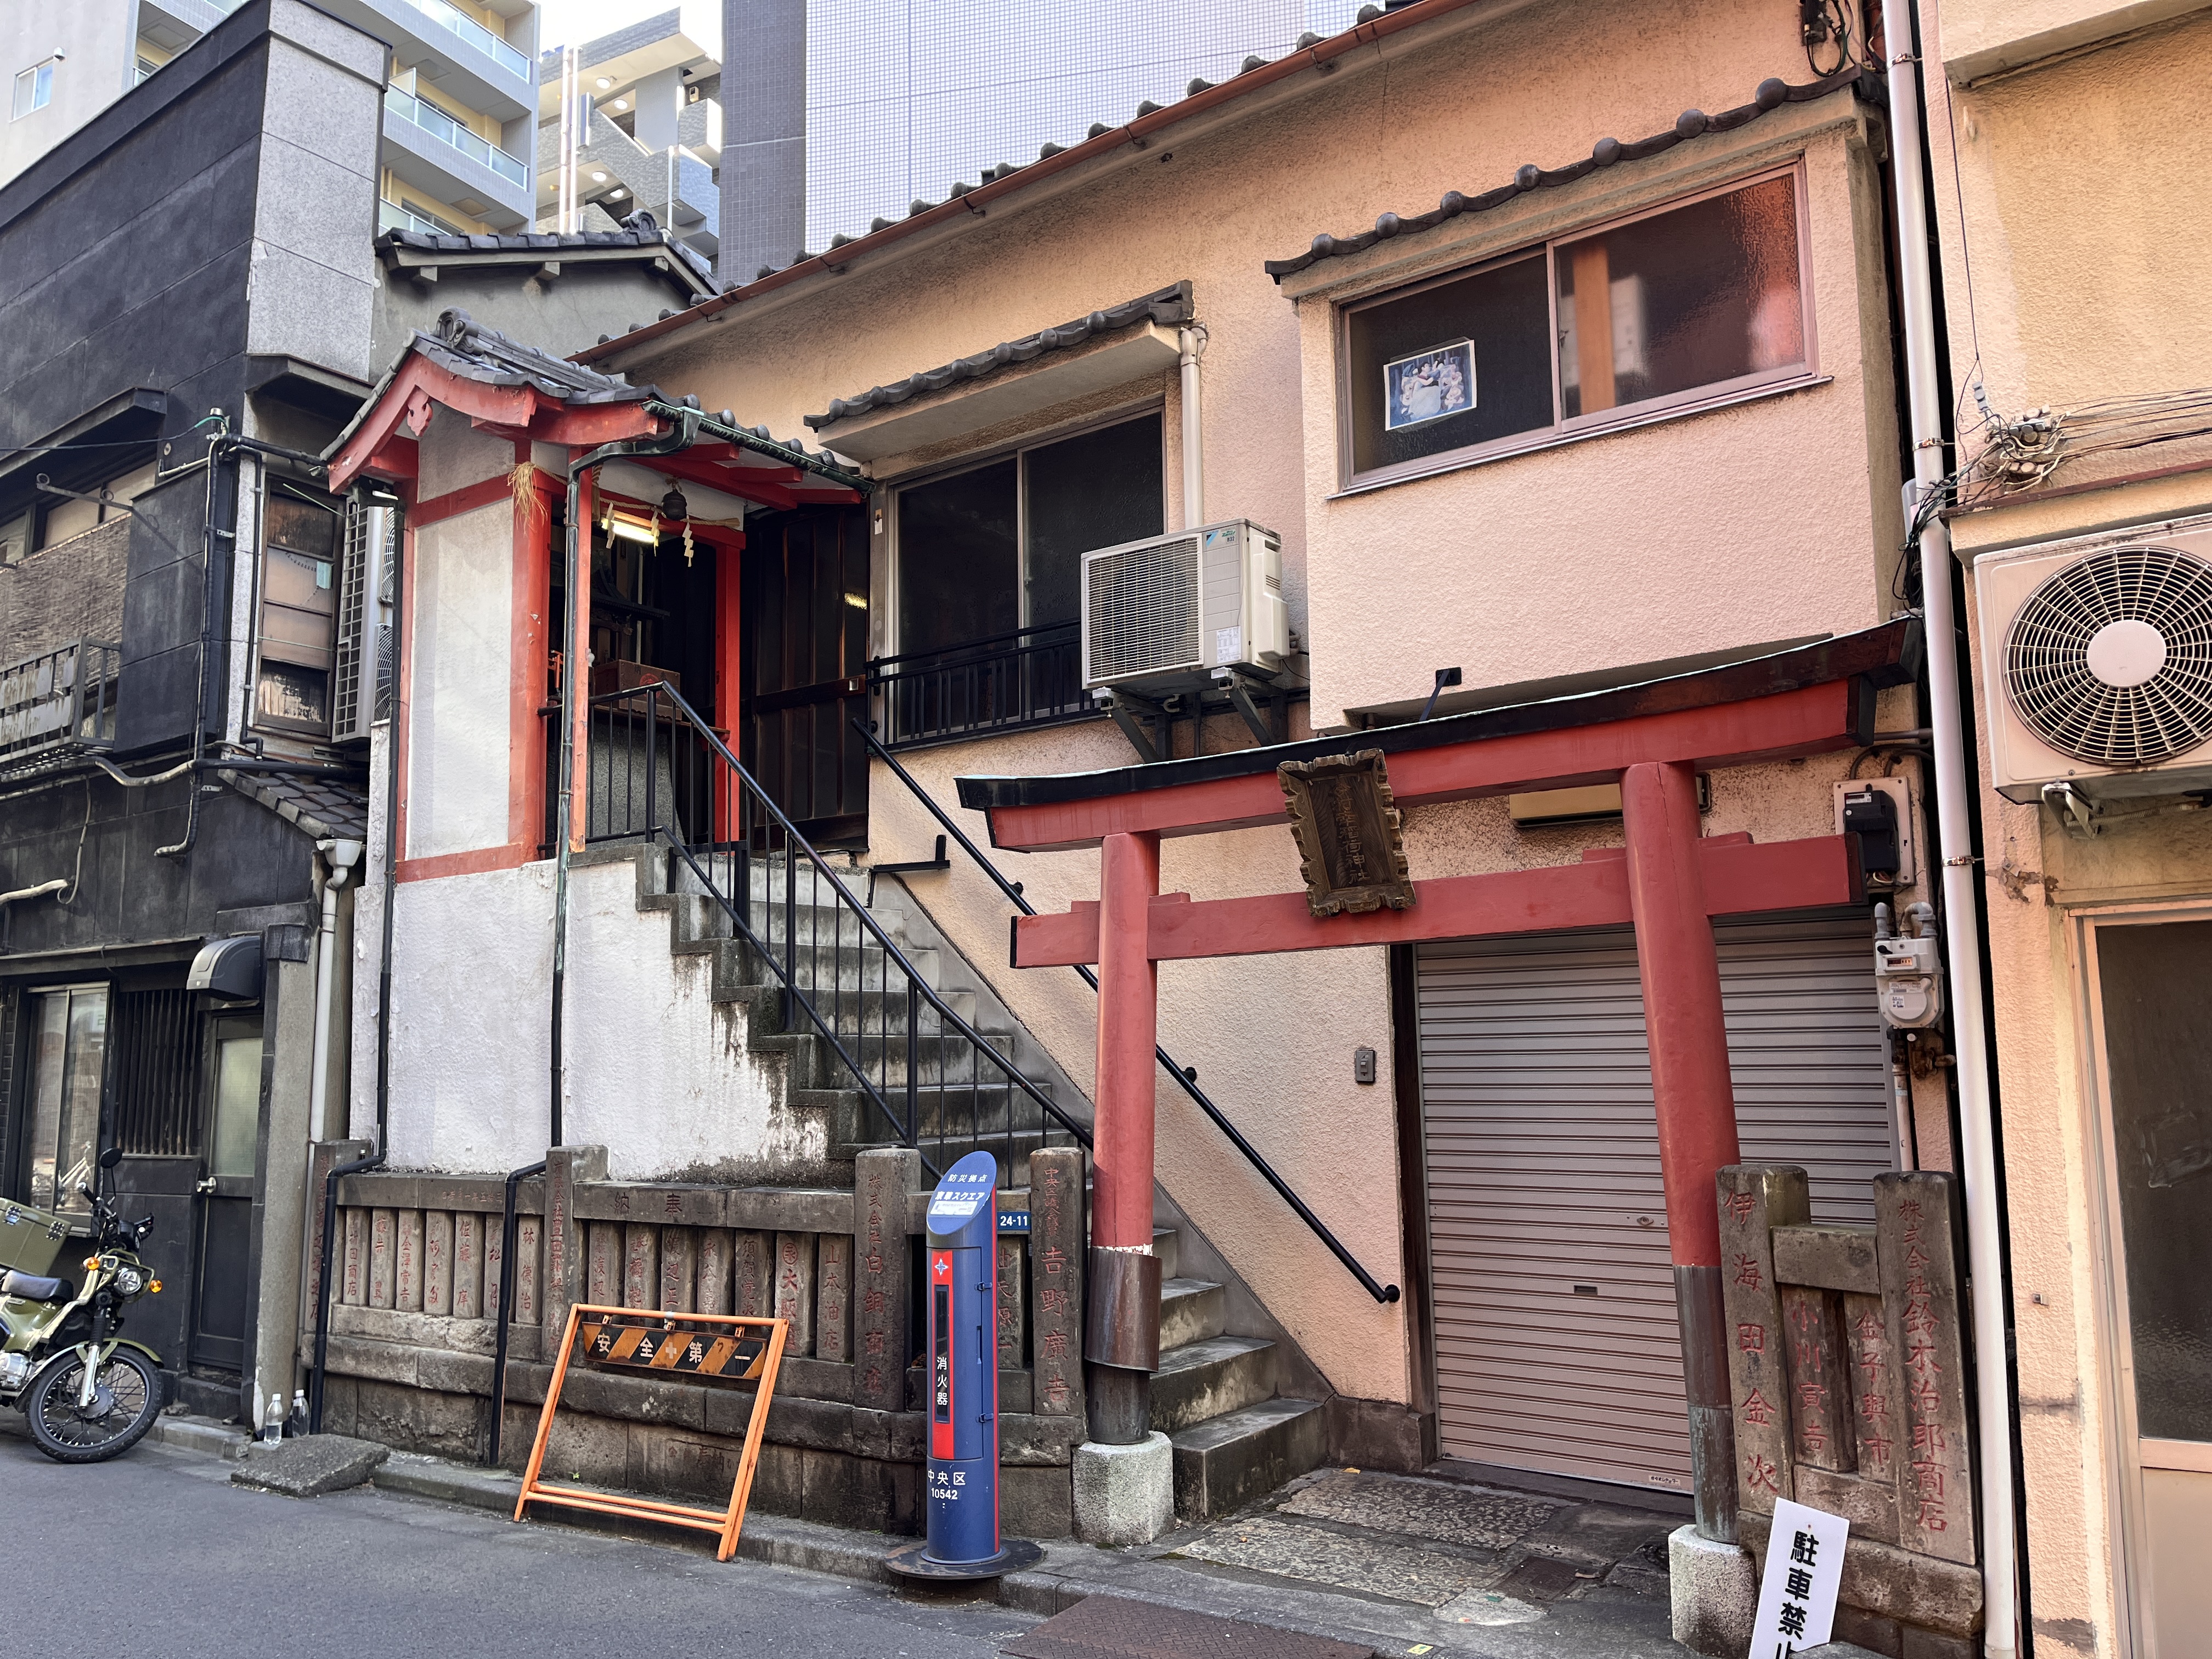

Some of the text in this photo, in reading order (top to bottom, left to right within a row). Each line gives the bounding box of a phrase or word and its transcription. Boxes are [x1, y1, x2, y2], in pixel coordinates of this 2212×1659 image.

[935, 1190, 985, 1201] 京華スクエア
[1000, 1215, 1028, 1226] 24-11
[936, 1356, 948, 1406] 消火器
[928, 1469, 966, 1486] 中央区
[931, 1487, 958, 1500] 10542
